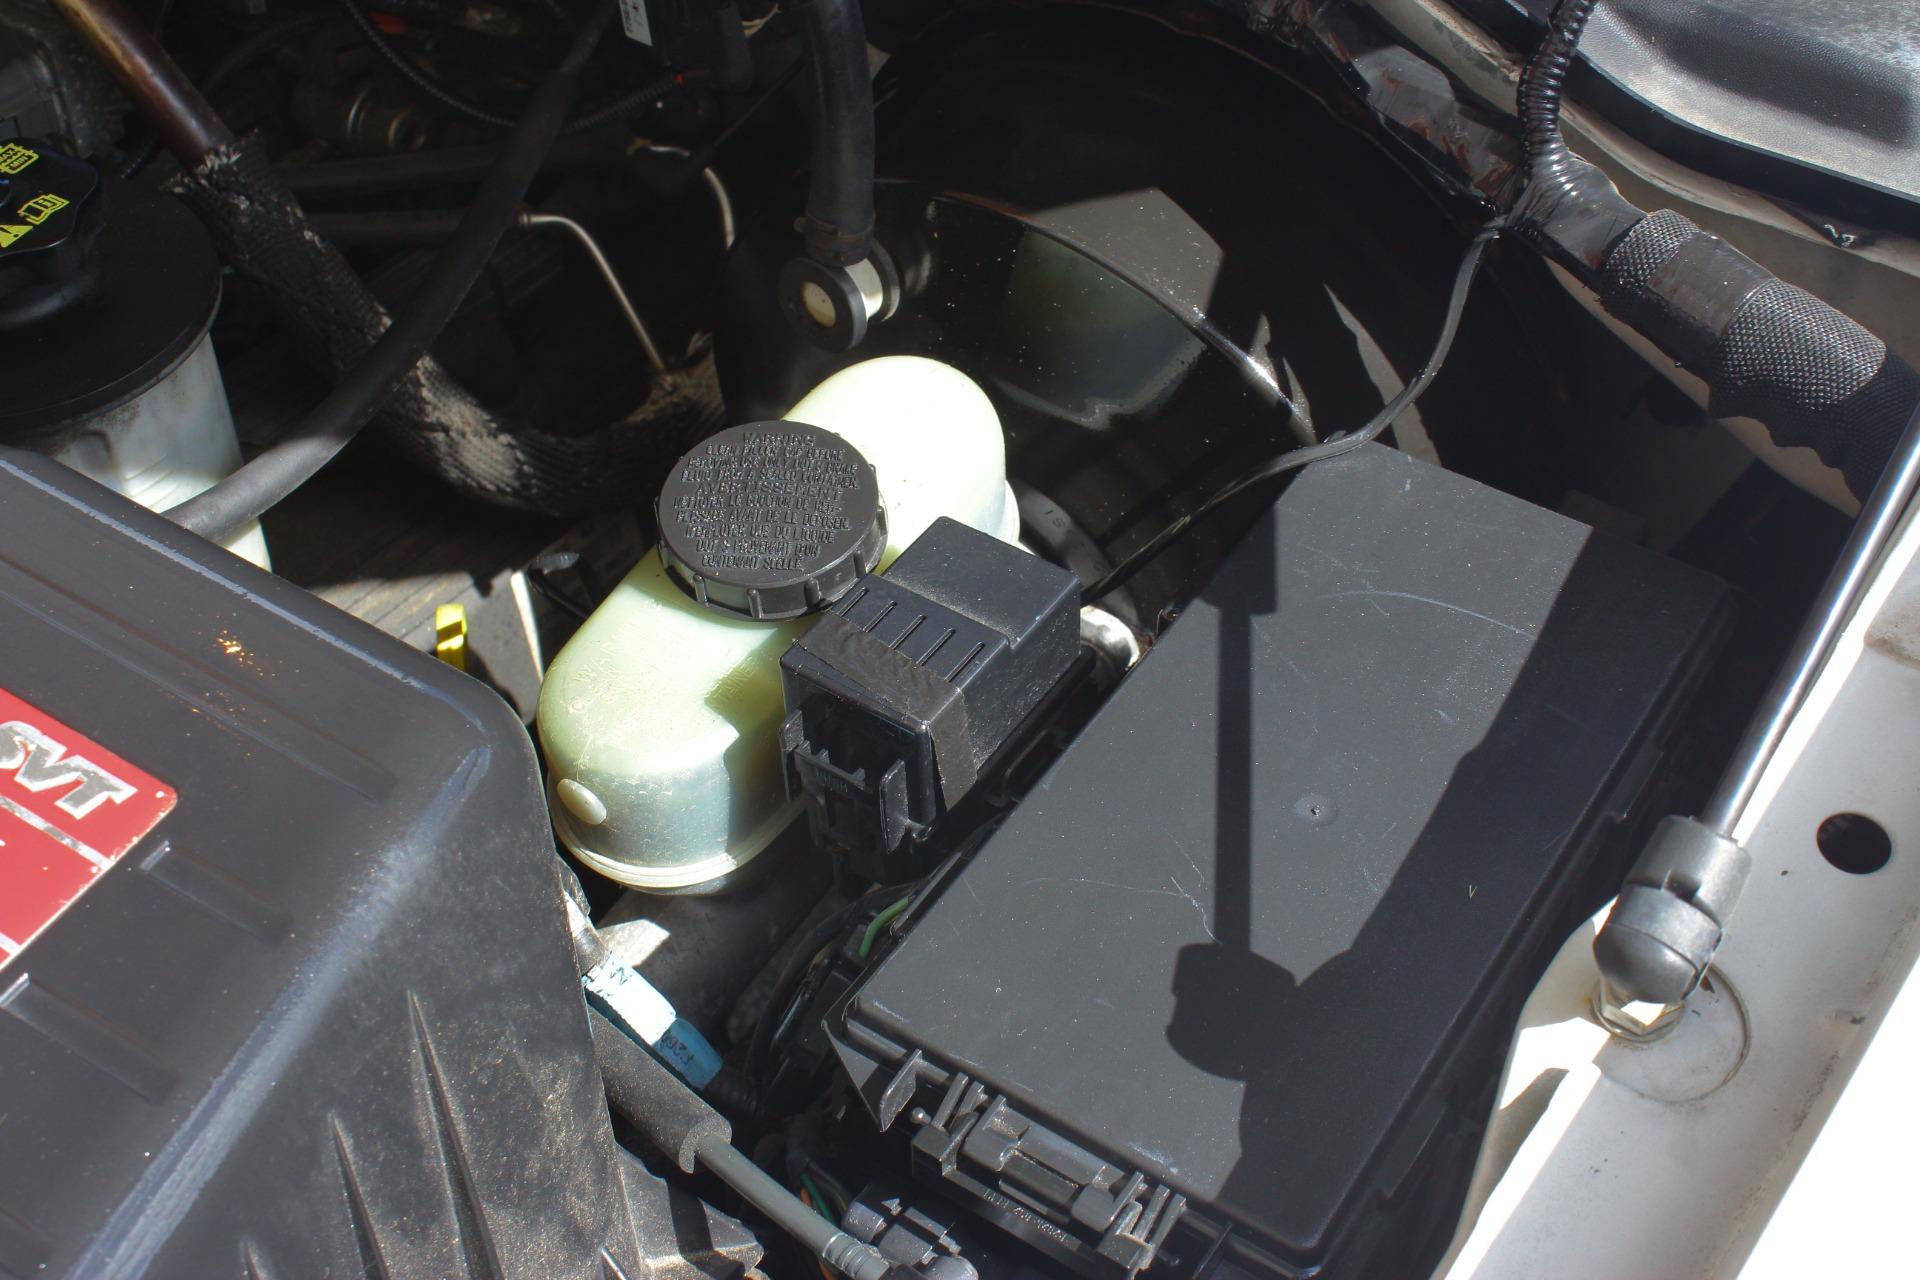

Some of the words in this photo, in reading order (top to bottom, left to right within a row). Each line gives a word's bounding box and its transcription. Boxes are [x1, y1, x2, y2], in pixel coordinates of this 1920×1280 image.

[742, 432, 816, 447] WARNING
[696, 480, 842, 501] AVERTISSEMENT
[729, 508, 762, 522] AVANT
[783, 511, 798, 525] LE
[0, 720, 138, 820] SVT
